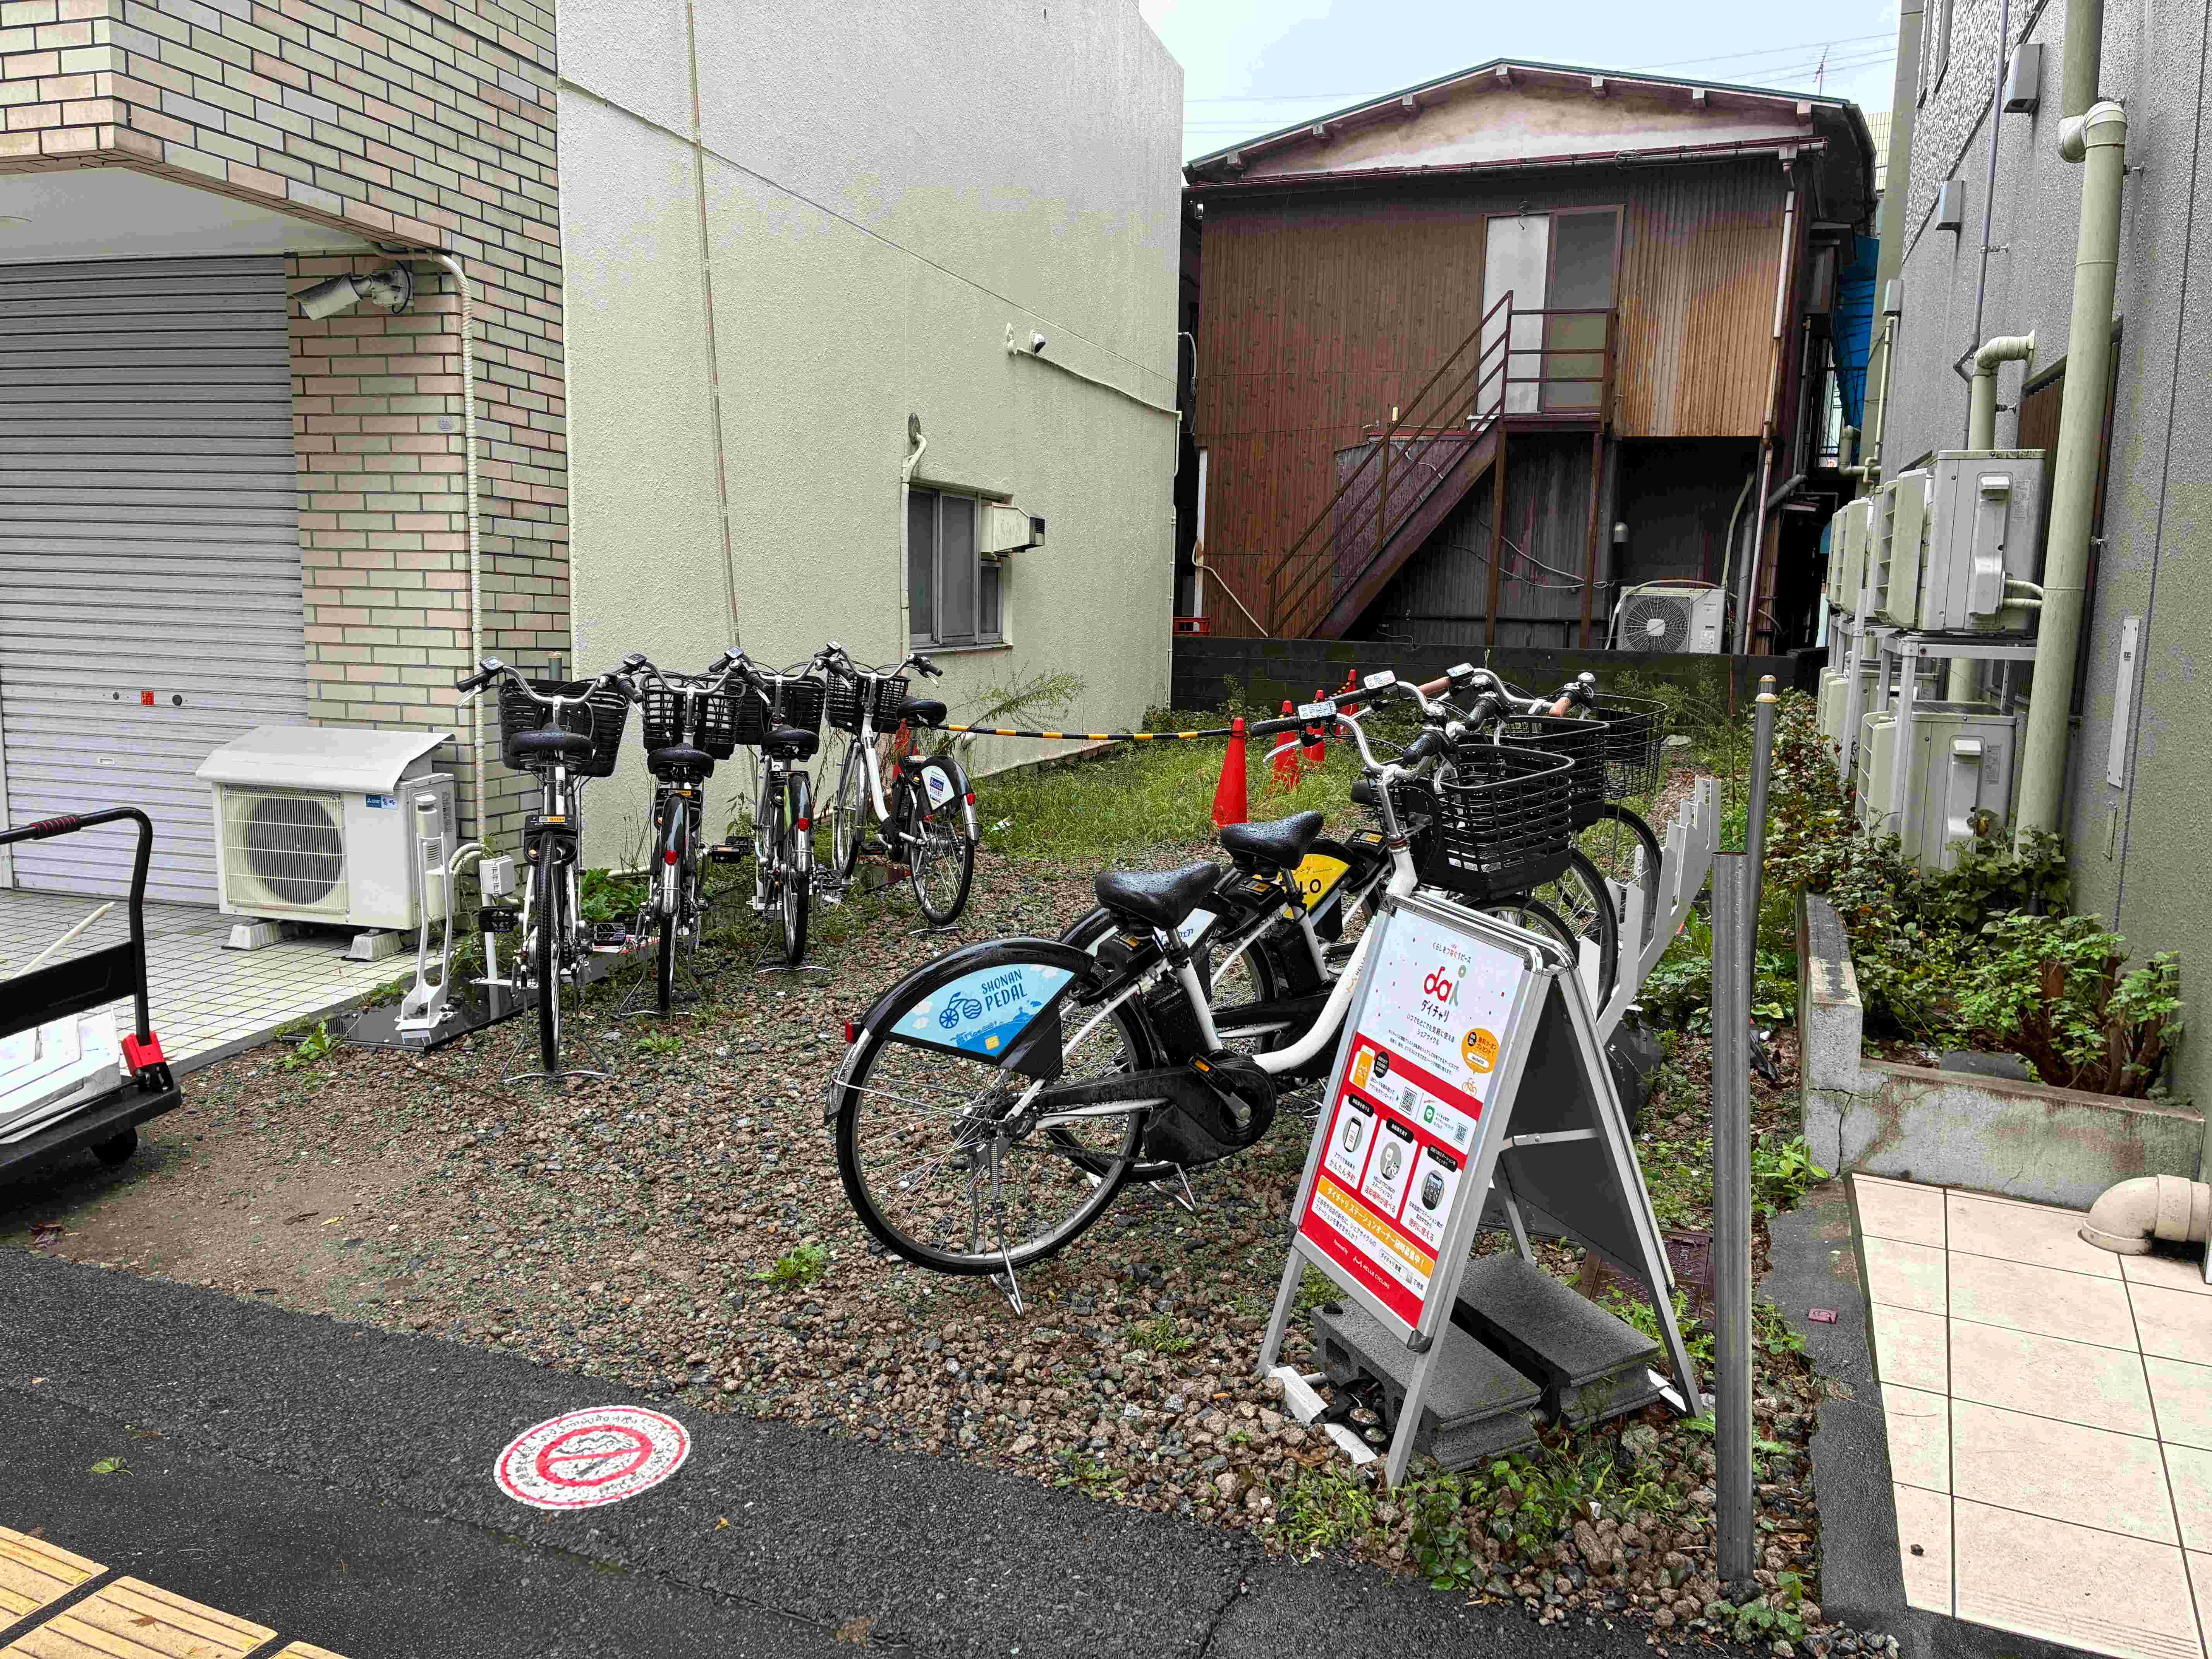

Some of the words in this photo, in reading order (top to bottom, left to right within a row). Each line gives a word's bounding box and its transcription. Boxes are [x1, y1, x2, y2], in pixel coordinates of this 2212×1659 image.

[981, 969, 1022, 994] SHONAN
[985, 982, 1028, 1011] PEDAL
[1421, 1000, 1449, 1022] ダイチャリ
[1327, 1187, 1350, 1208] ダイチャリ
[1362, 1264, 1375, 1277] HELLO
[1374, 1273, 1390, 1289] CYCLING
